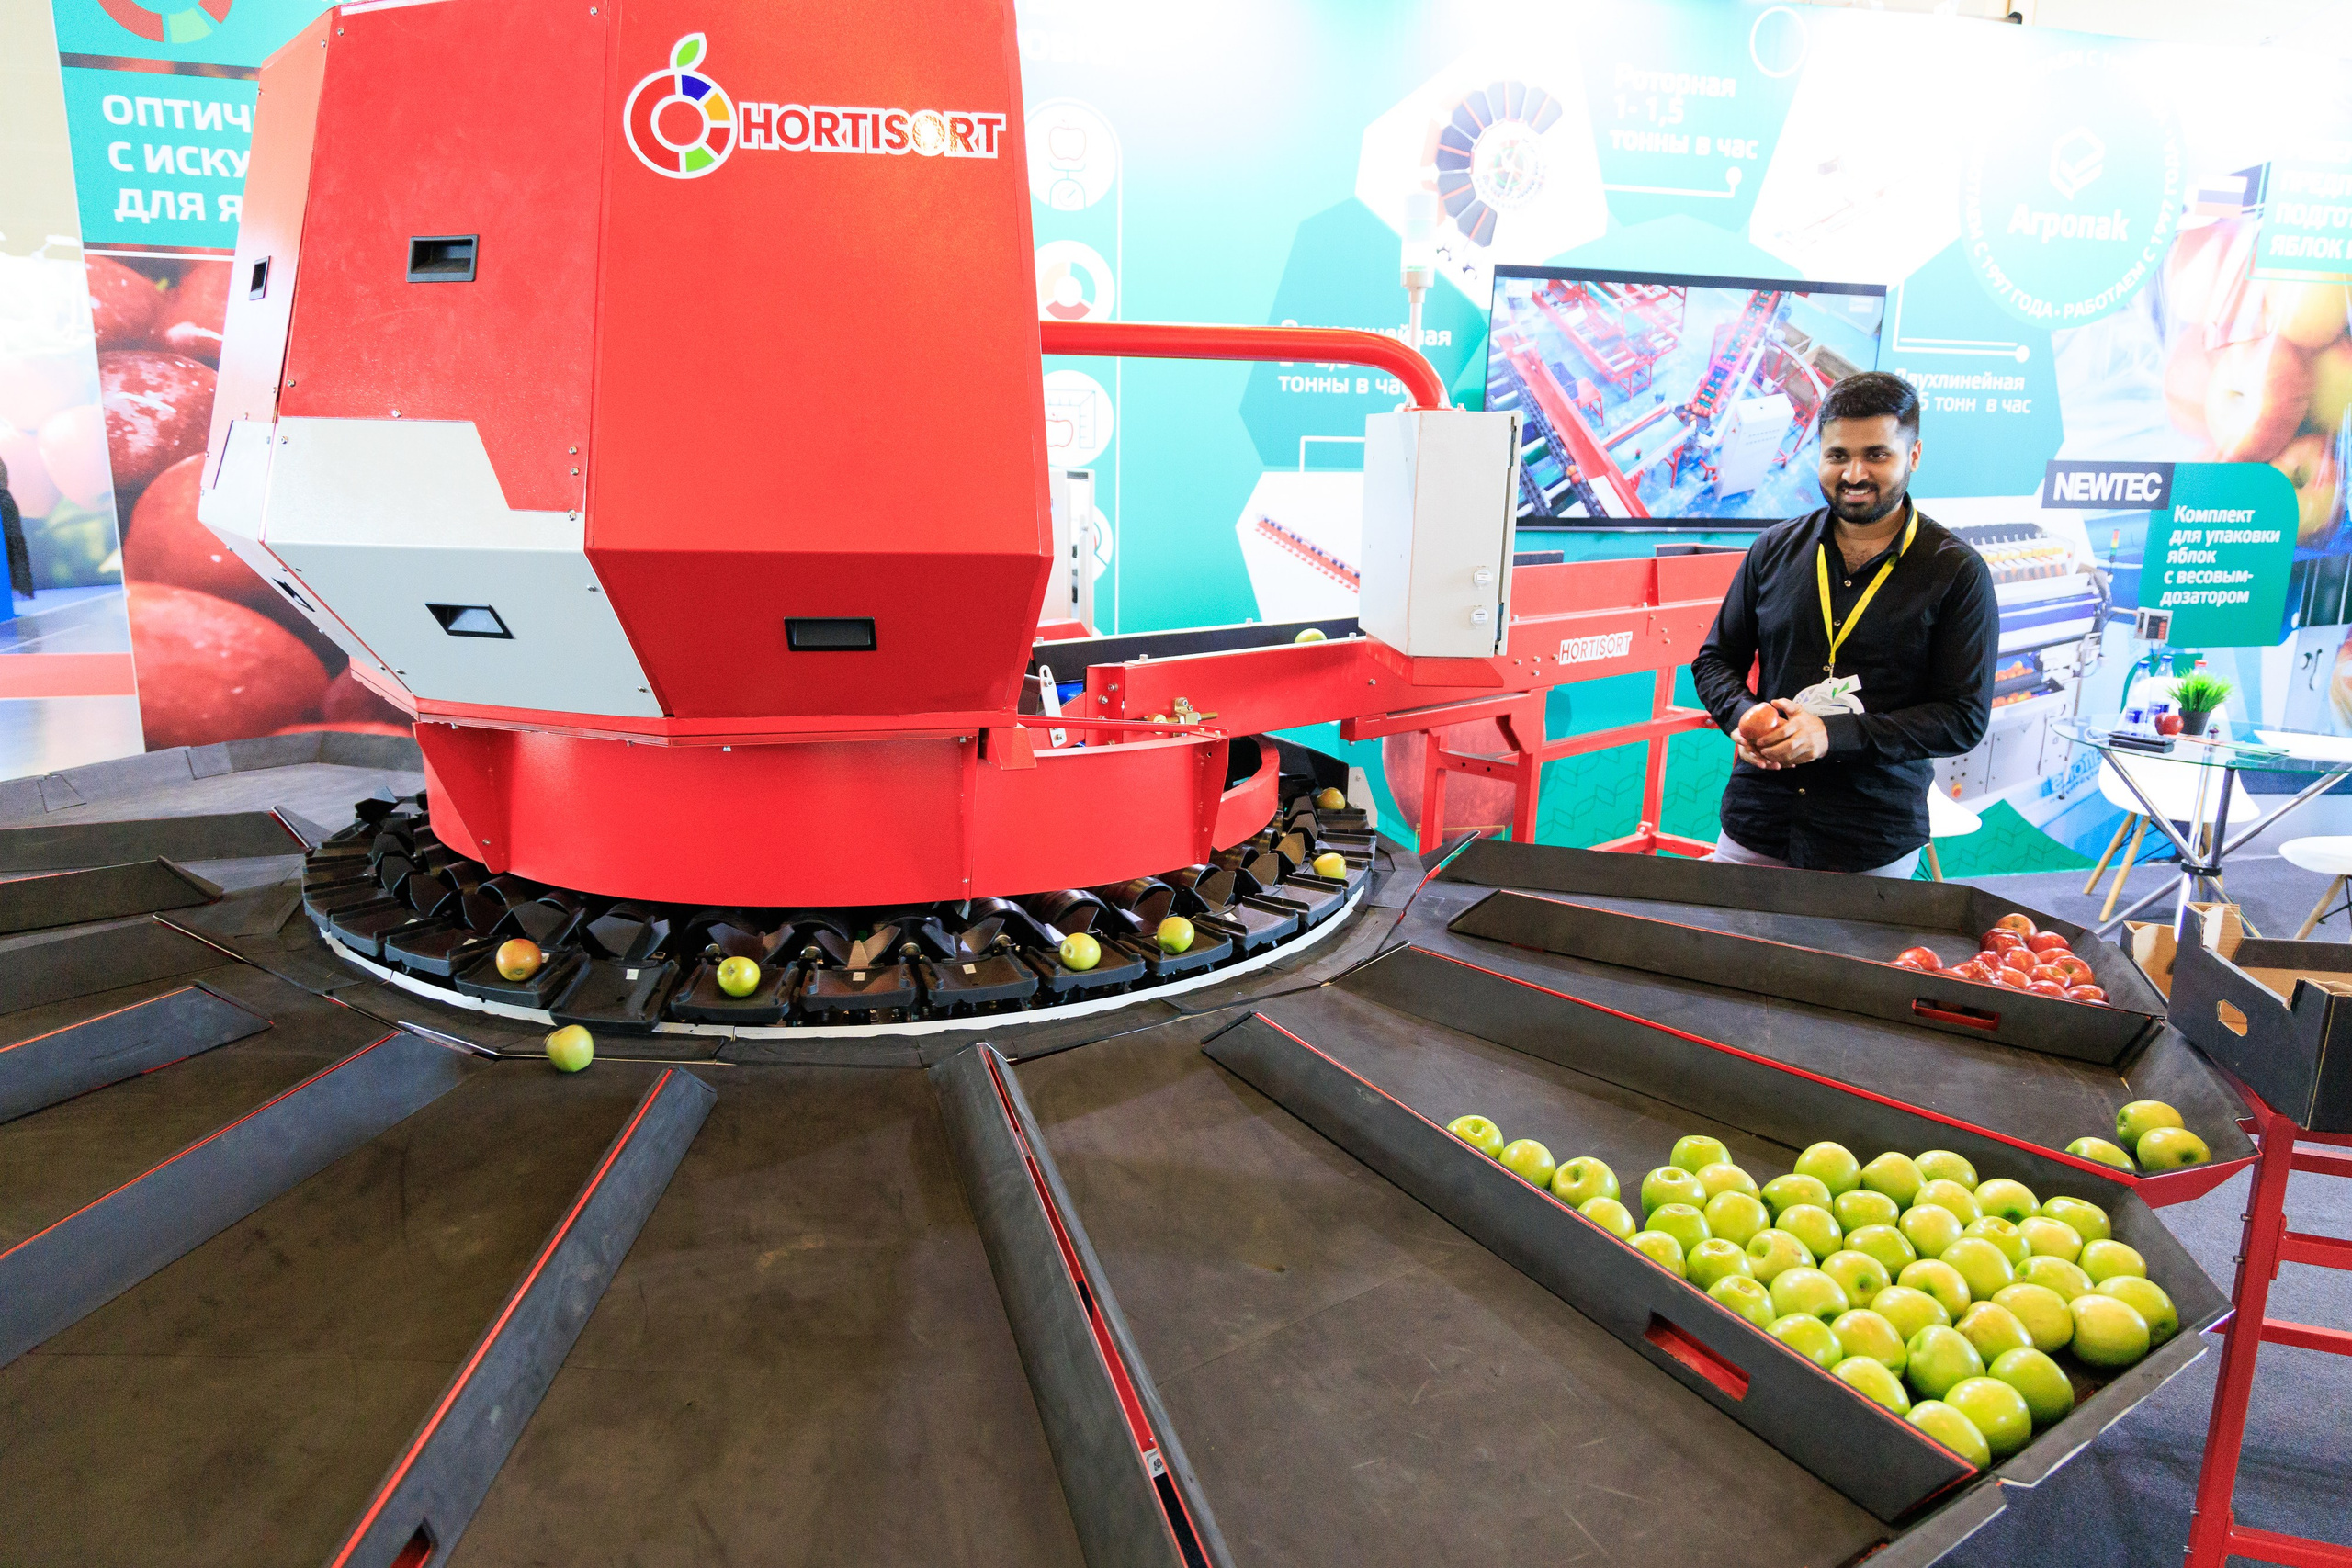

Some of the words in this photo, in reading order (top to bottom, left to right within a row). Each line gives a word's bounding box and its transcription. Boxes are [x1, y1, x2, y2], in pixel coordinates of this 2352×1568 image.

[1613, 62, 1736, 97] Роторная
[102, 94, 257, 133] ОПТИЧ
[1646, 96, 1685, 128] 1,5
[739, 100, 1006, 159] HORTISORT
[1610, 129, 1690, 154] тонны
[1695, 136, 1711, 156] в
[1716, 137, 1758, 160] час
[108, 141, 134, 172] С
[113, 187, 207, 224] ДЛЯ
[2064, 261, 2146, 320] РАБОТАЕМ
[2143, 246, 2157, 263] С
[2150, 198, 2175, 246] 1997
[2269, 234, 2345, 260] ЯБЛОК
[1973, 241, 1989, 257] С
[1981, 256, 2013, 294] 1997
[2011, 288, 2052, 320] ГОДА
[1277, 375, 1349, 393] тонны
[1356, 378, 1368, 393] в
[1934, 396, 1976, 412] тонн
[1986, 398, 1997, 412] в
[2002, 399, 2032, 413] час
[2052, 471, 2163, 502] NEWTEC
[2173, 504, 2256, 524] Комплект
[2168, 529, 2202, 547] для
[2205, 529, 2281, 547] упаковки
[2166, 547, 2217, 564] яблок
[2164, 570, 2173, 584] с
[2176, 570, 2254, 585] весовым-
[2159, 590, 2250, 607] дозатором
[1559, 633, 1632, 663] HORTISORT
